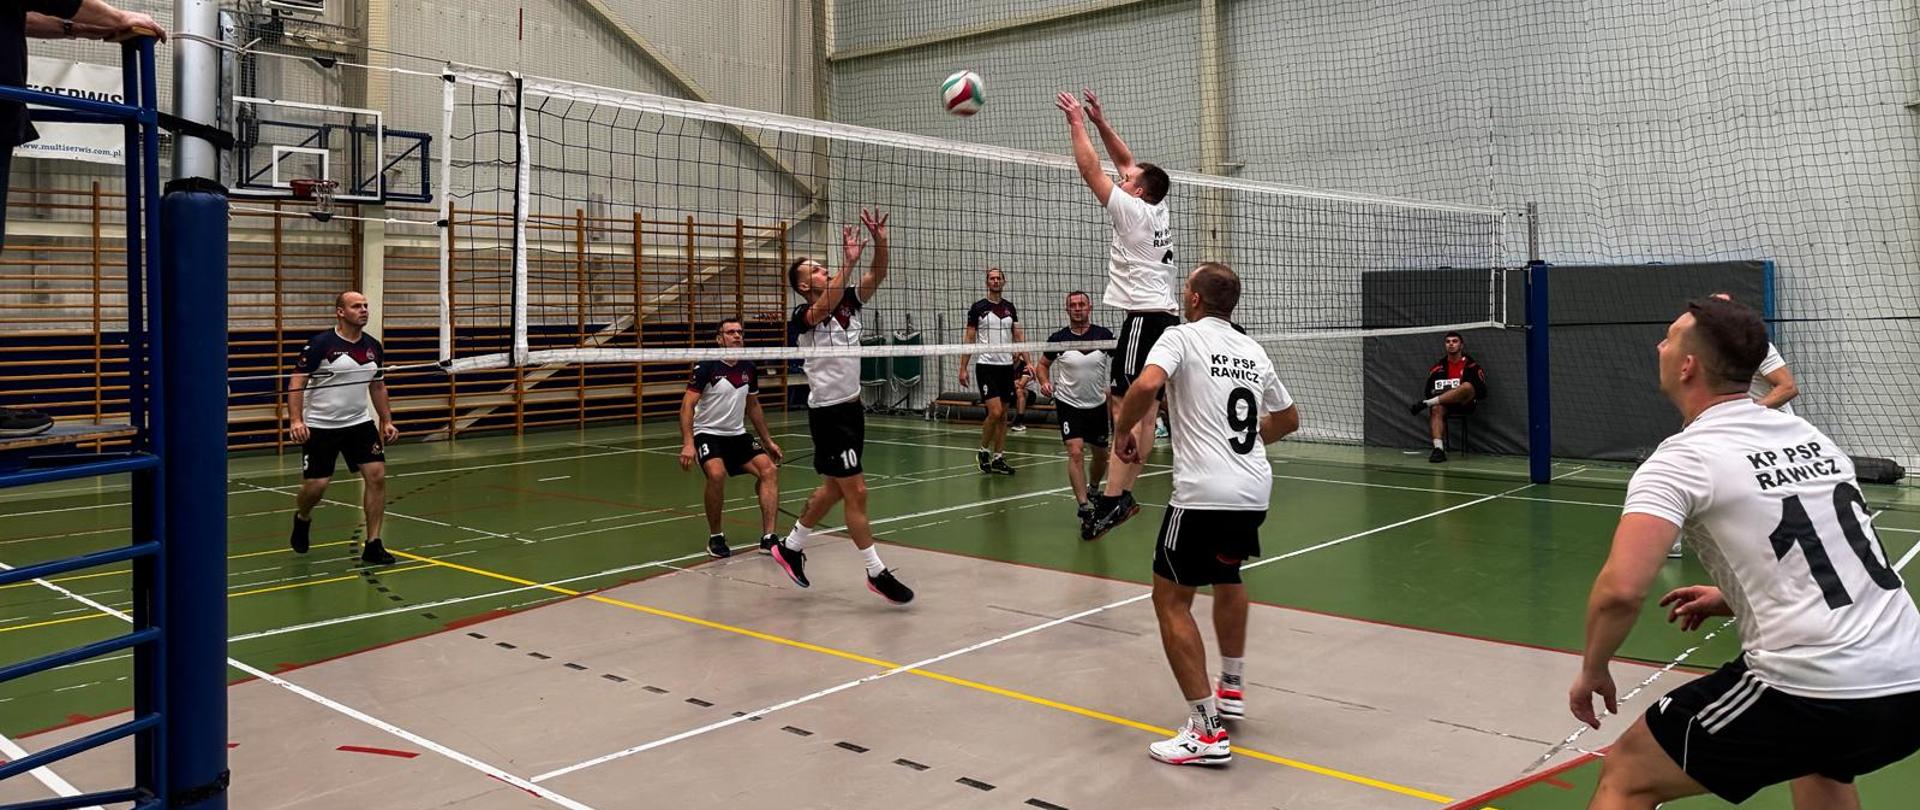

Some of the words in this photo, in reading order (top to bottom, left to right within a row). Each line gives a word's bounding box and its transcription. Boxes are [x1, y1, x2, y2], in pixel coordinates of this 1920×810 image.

[1211, 354, 1229, 365] KP
[1232, 357, 1256, 370] PSP
[1210, 367, 1260, 383] RAWICZ
[1063, 421, 1070, 435] 8
[1227, 386, 1258, 455] 9
[303, 454, 309, 470] 5
[841, 448, 858, 470] 10
[1747, 451, 1778, 469] KP
[1783, 442, 1822, 463] PSP
[1755, 459, 1842, 490] RAWICZ
[1769, 481, 1903, 611] 10
